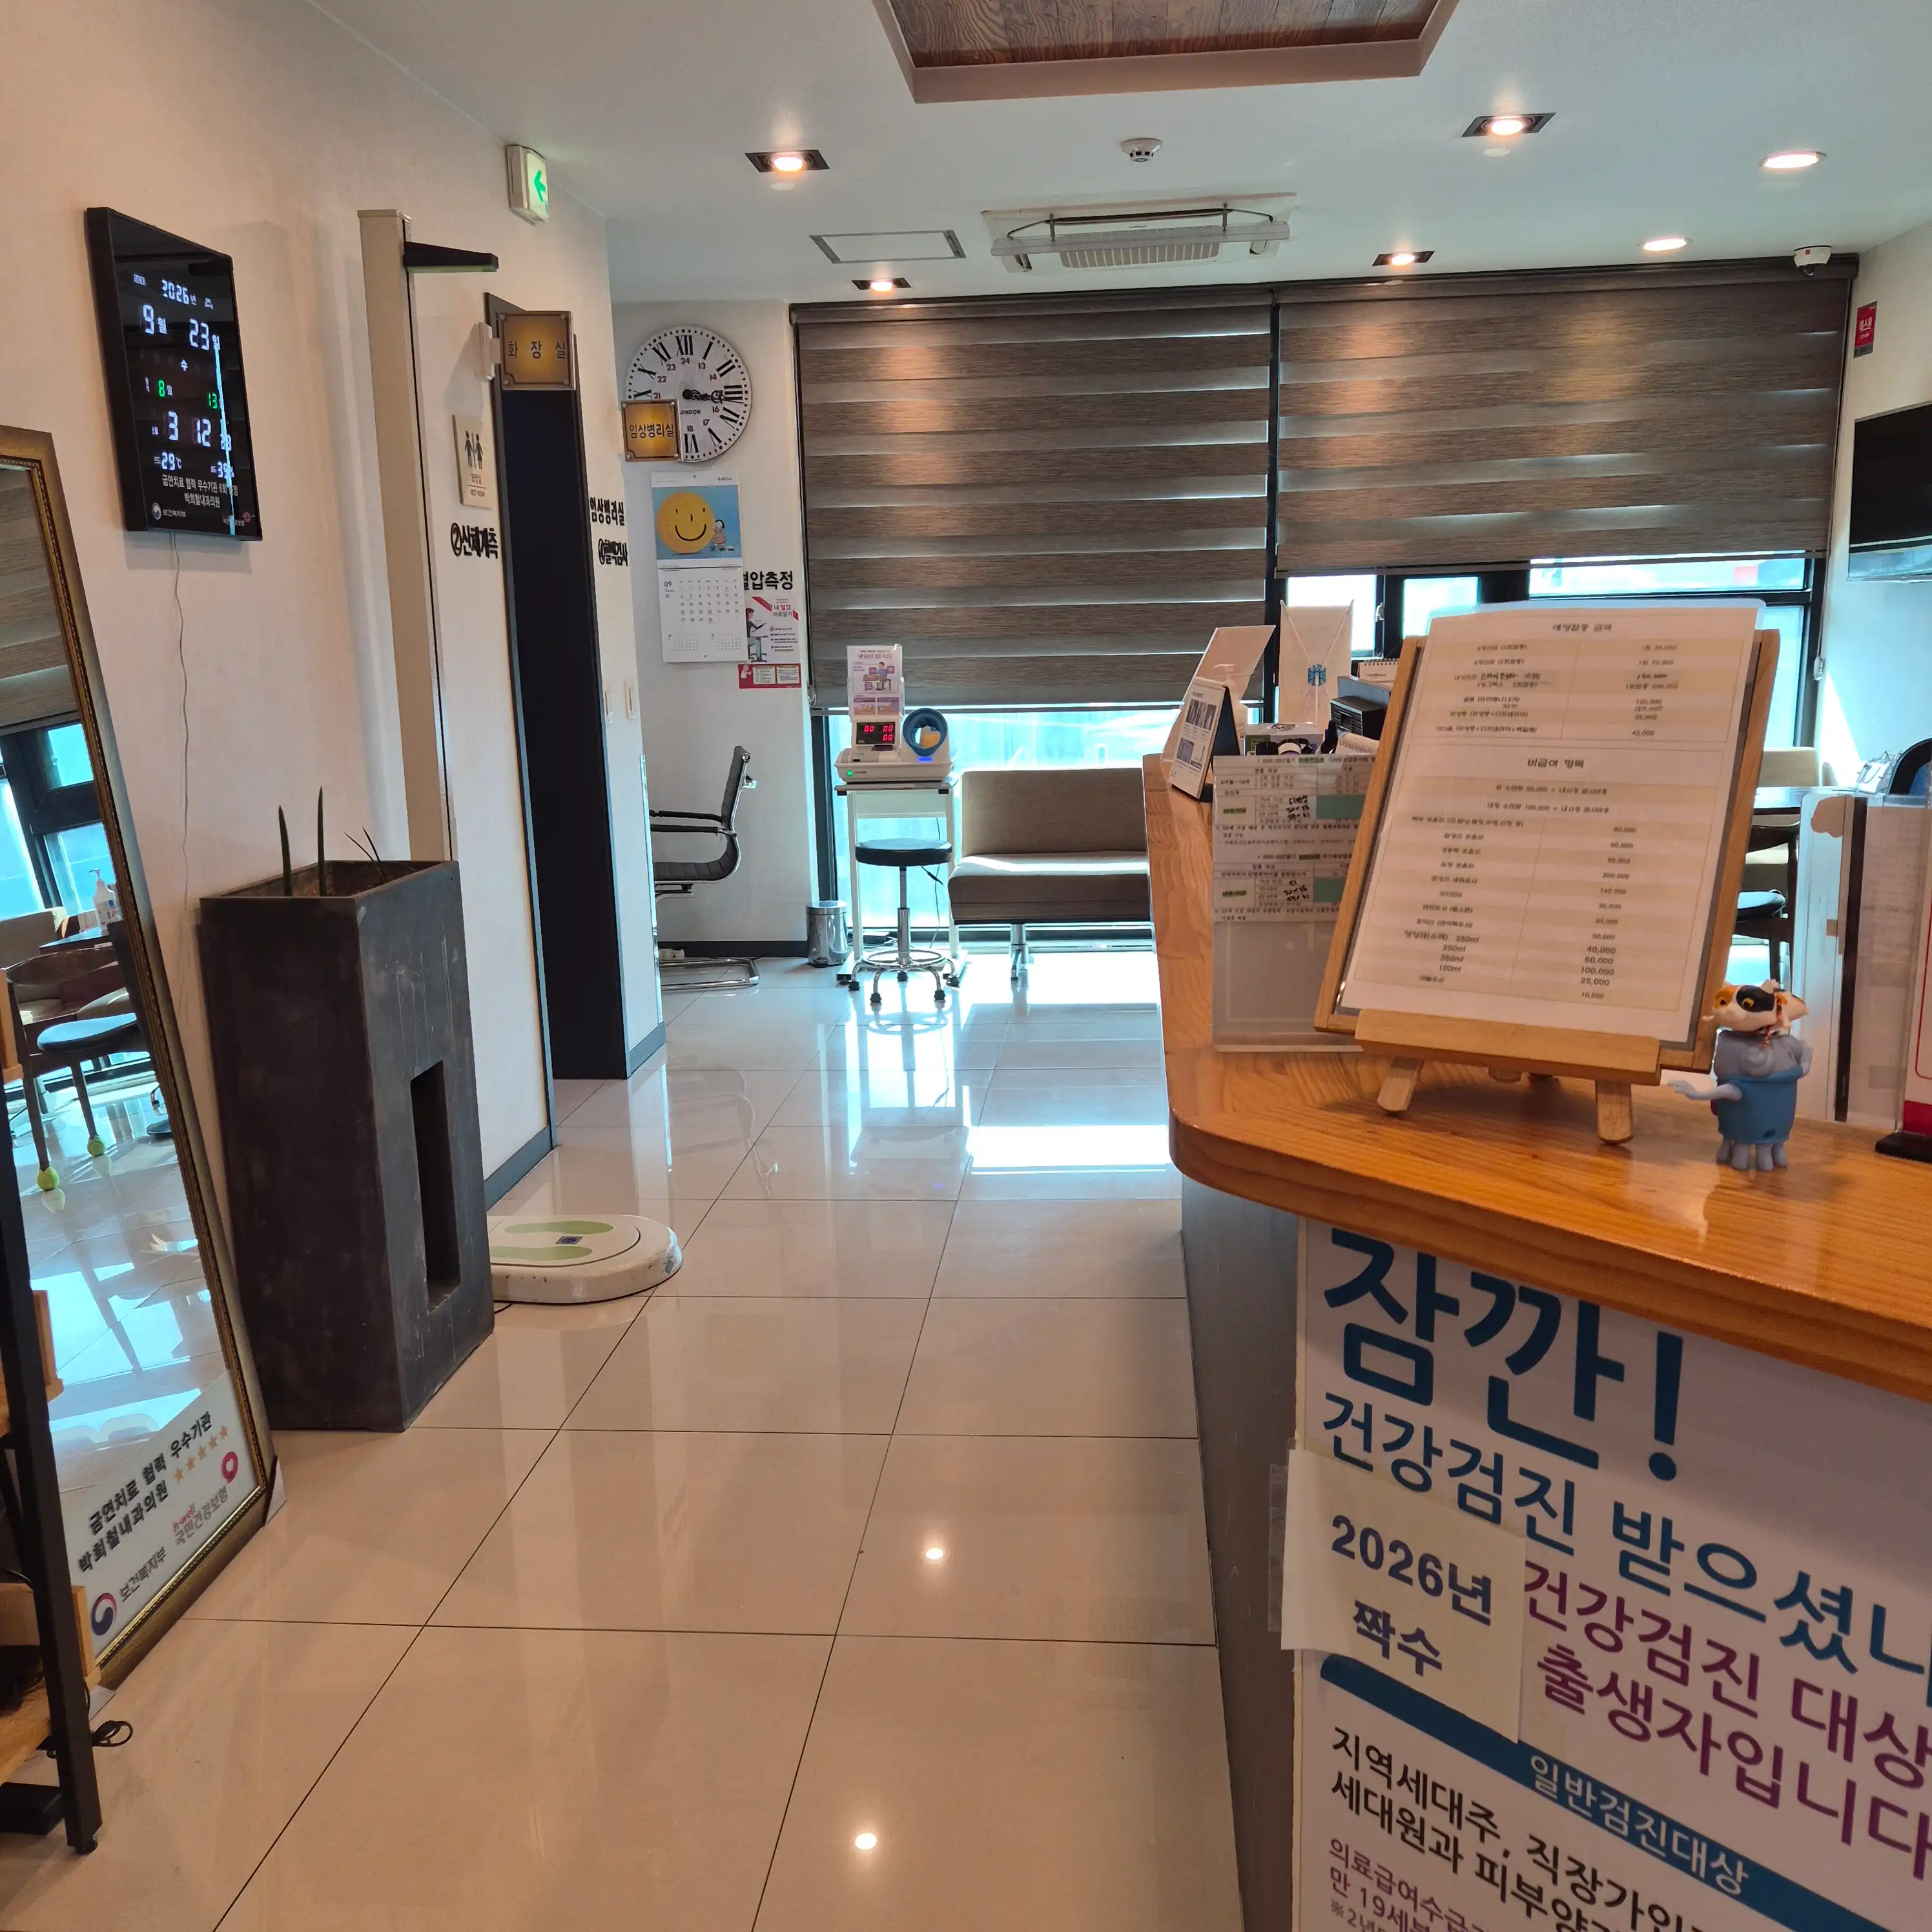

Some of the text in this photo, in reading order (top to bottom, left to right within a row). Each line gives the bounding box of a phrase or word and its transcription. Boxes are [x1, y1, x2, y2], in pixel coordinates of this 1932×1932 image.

[507, 340, 566, 360] 화장실
[629, 423, 674, 439] 임상병리실
[162, 474, 185, 488] 금연치료
[185, 478, 196, 491] 협력
[198, 480, 218, 493] 우수기관
[184, 492, 220, 508] 박희철내과의원
[590, 497, 624, 526] 임상병리실
[1527, 758, 1558, 768] 비급여
[1324, 1228, 1684, 1481] 잠깐!
[88, 1411, 212, 1536] 금연치료 협력 우수기관
[1323, 1392, 1576, 1557] 건강검진
[77, 1479, 169, 1574] 박희철내과의원
[174, 1485, 229, 1547] 국민건강보험
[119, 1546, 167, 1603] 보건복지부
[1331, 1514, 1492, 1626] 2026년
[1353, 1599, 1443, 1677] 짝수
[1525, 1560, 1932, 1789] 건강검진 대상
[1537, 1643, 1932, 1881] 출생자입니다
[1331, 1771, 1464, 1874] 세대원과
[1530, 1755, 1749, 1895] 일반검진대상
[1330, 1866, 1350, 1898] 만
